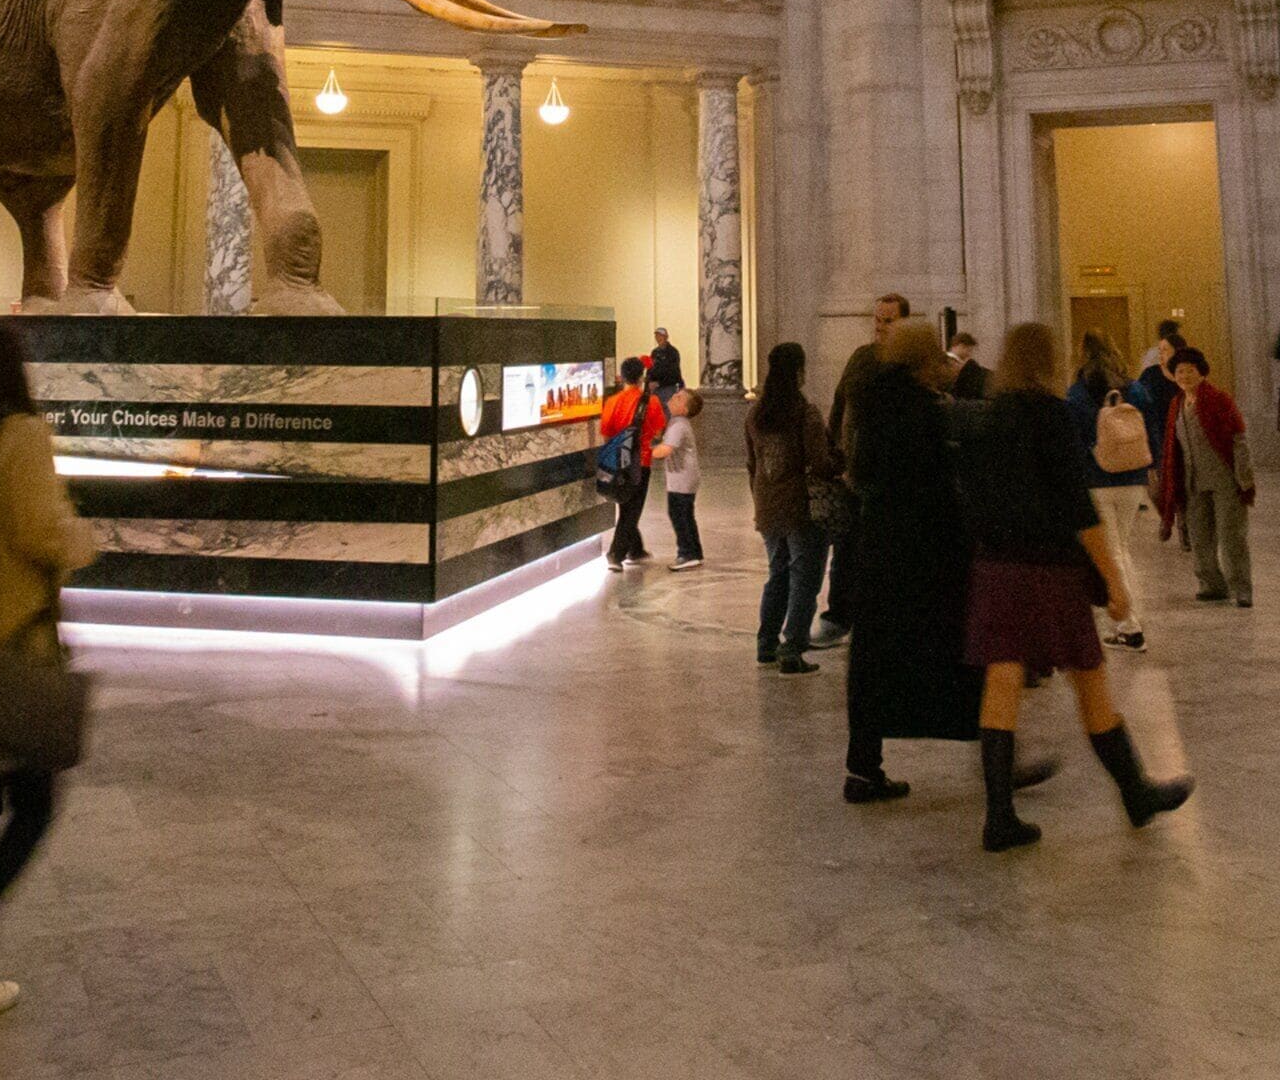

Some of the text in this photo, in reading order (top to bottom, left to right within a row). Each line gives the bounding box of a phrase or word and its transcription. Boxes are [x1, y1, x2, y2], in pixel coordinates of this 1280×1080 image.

[70, 408, 108, 425] Your
[111, 409, 178, 427] Choices
[182, 411, 226, 428] Make
[230, 415, 240, 428] a
[245, 412, 333, 431] Difference
